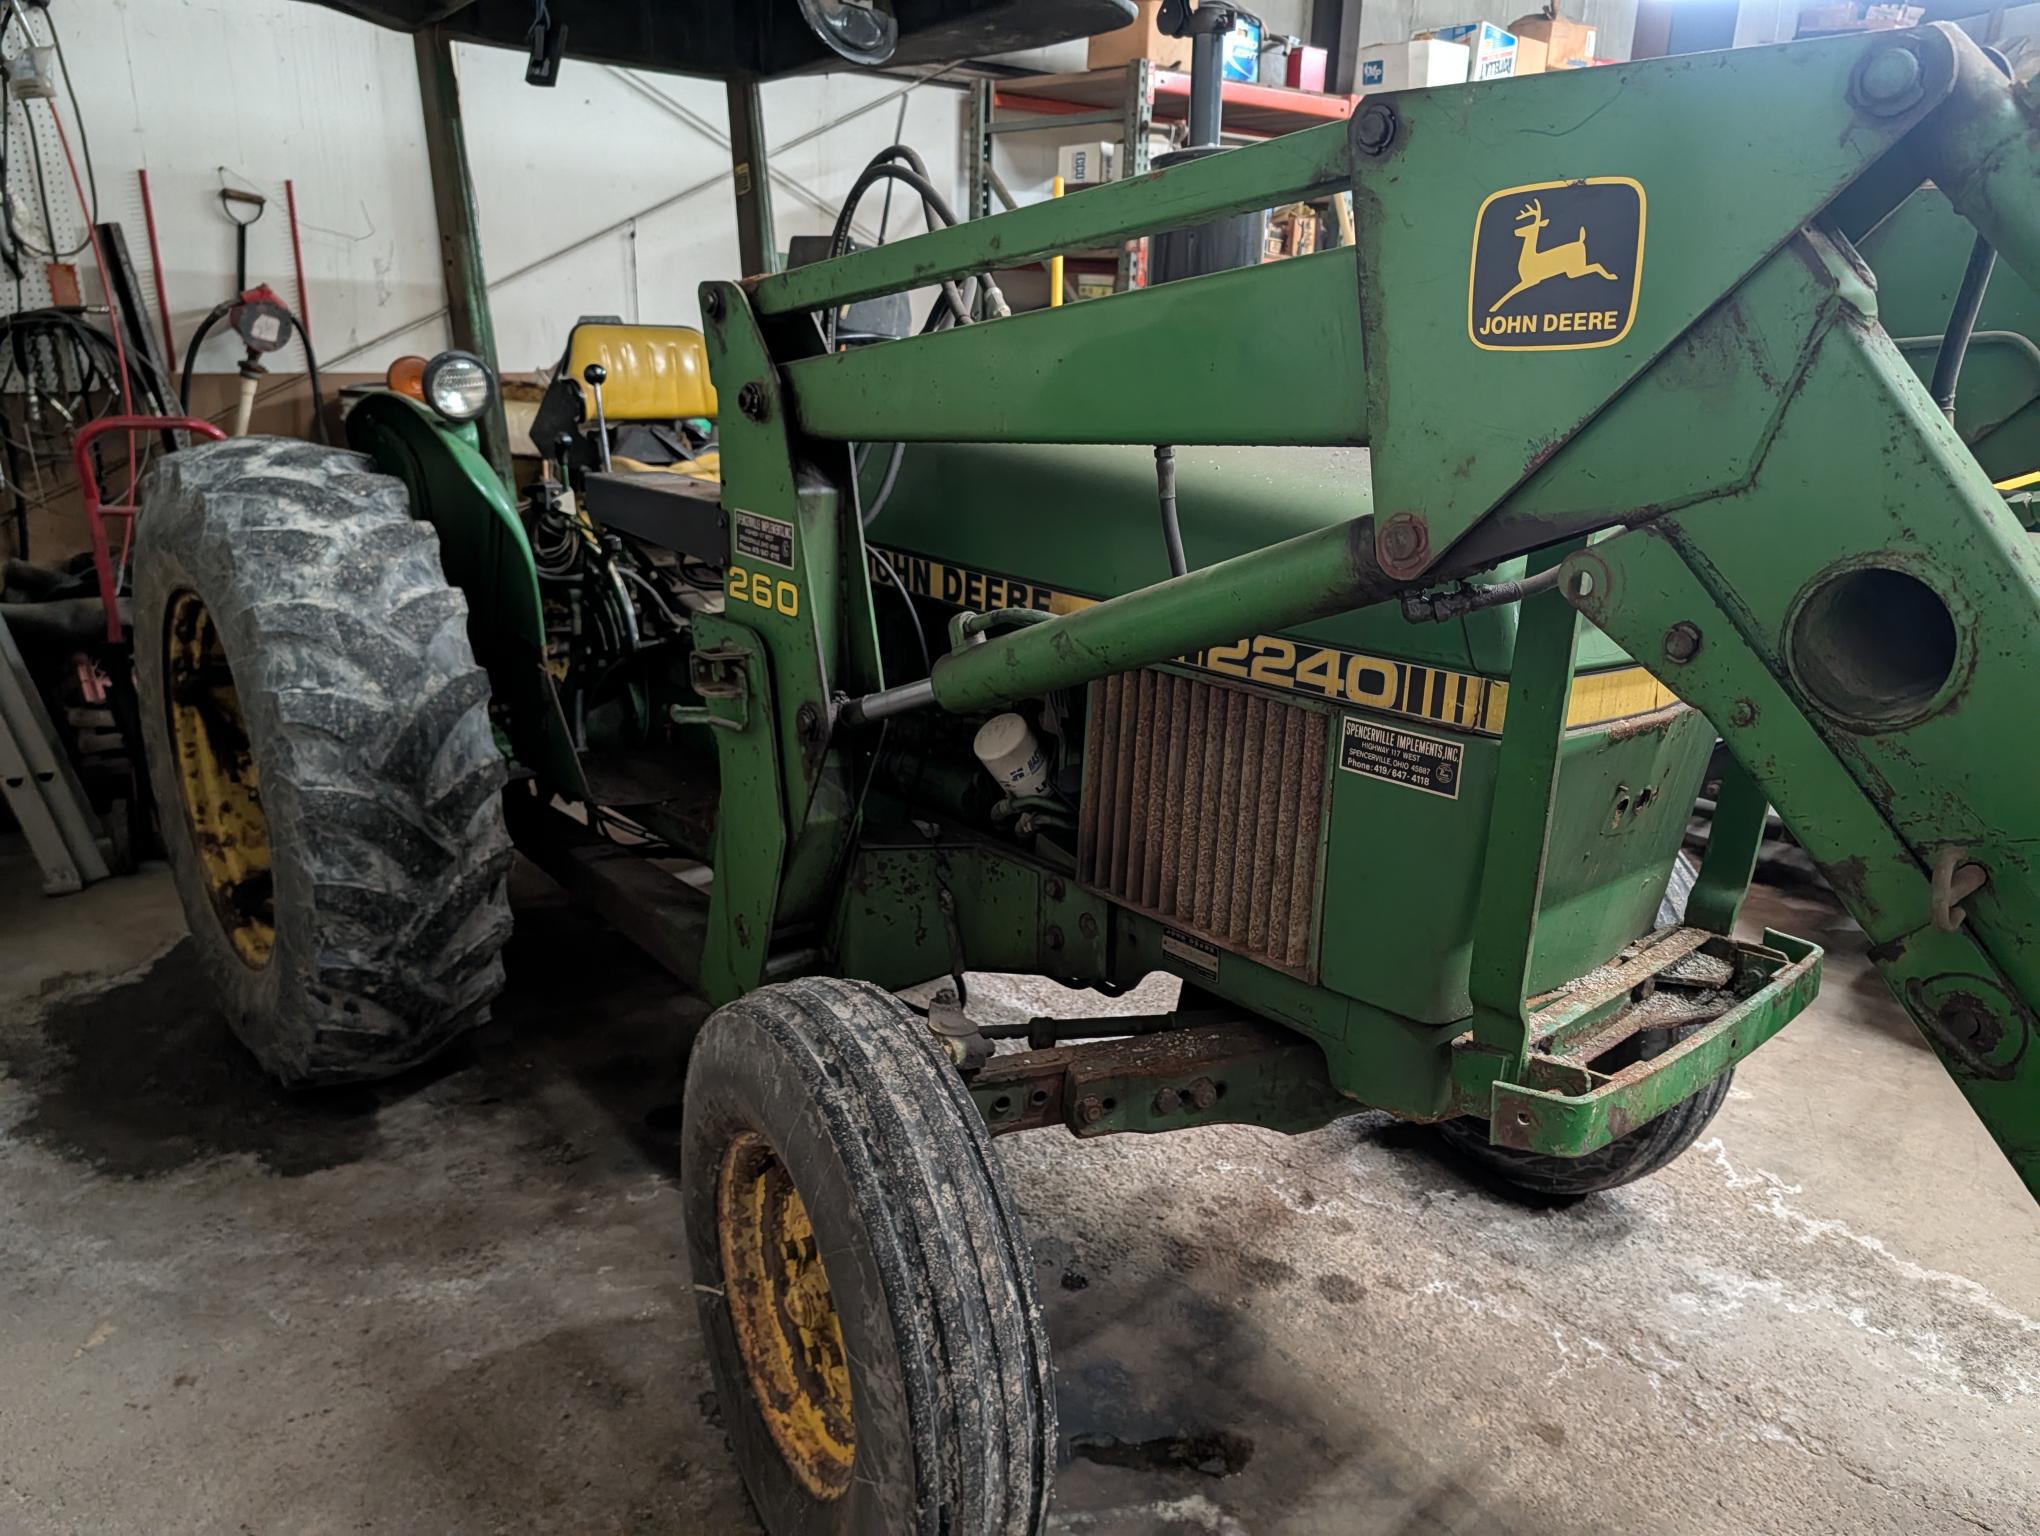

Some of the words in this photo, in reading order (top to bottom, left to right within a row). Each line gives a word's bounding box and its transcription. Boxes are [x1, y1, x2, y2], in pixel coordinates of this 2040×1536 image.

[1479, 314, 1538, 336] JOHN
[1543, 310, 1619, 333] DEERE
[728, 565, 799, 617] 260
[942, 565, 1052, 613] DEERE
[1207, 634, 1399, 708] 2240
[1346, 721, 1395, 747] SPENCERVILLE
[1361, 741, 1389, 755] HIGHWAY
[1391, 748, 1401, 757] 117
[1402, 751, 1421, 763] WEST
[1392, 759, 1410, 770] OHIO
